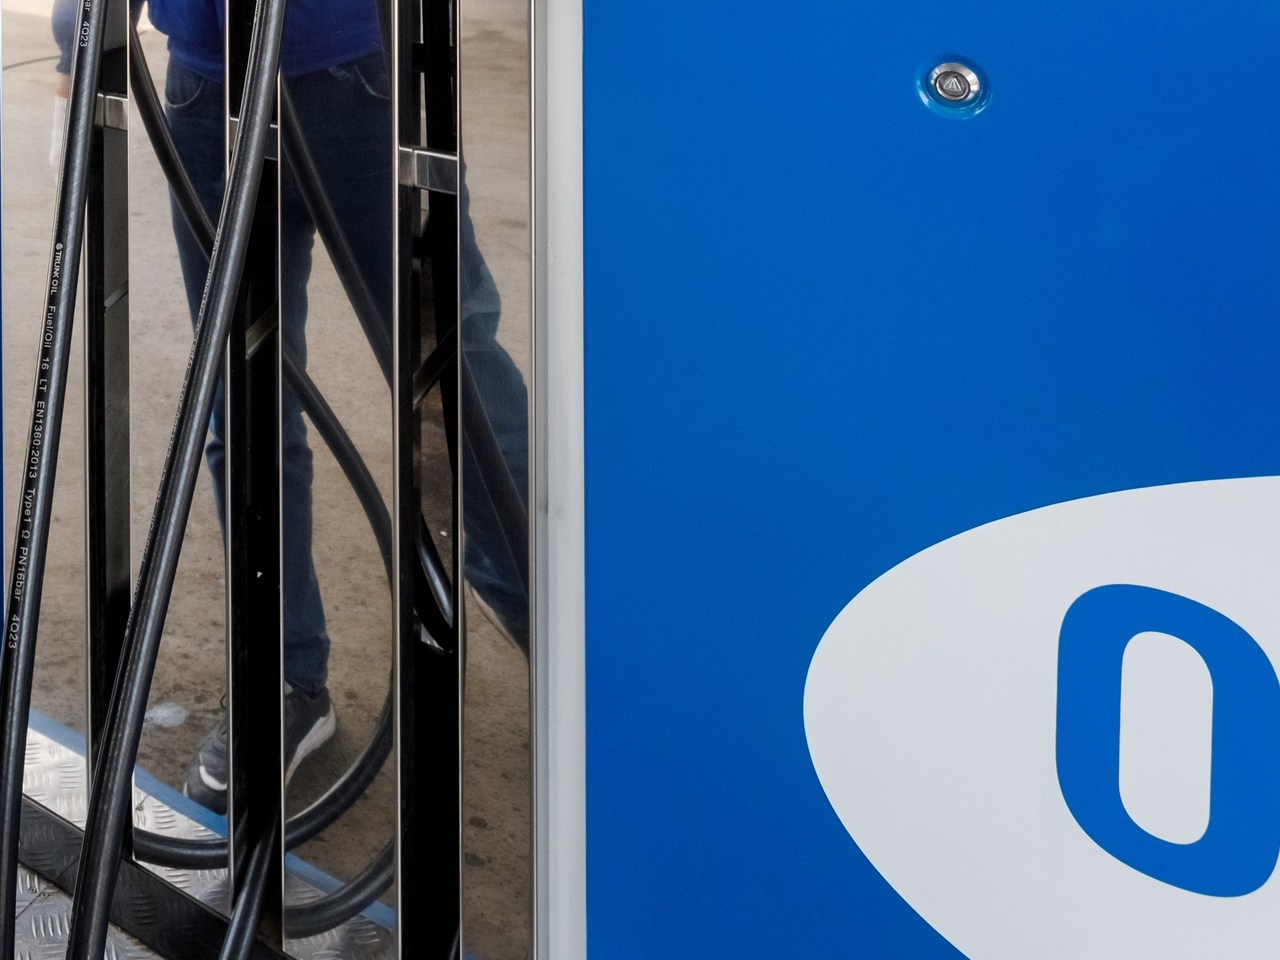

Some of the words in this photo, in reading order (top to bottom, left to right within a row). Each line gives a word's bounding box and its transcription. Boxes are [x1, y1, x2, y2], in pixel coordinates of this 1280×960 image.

[79, 21, 90, 47] 4Q23
[52, 250, 62, 278] TRUNK
[50, 279, 58, 295] OIL
[44, 305, 56, 348] Fuel/Oil
[41, 358, 50, 370] 16
[39, 379, 48, 392] LT
[28, 400, 45, 479] EN1360:2013
[24, 488, 36, 523] Type1
[14, 546, 29, 601] PN16bar
[8, 614, 20, 649] 4Q23
